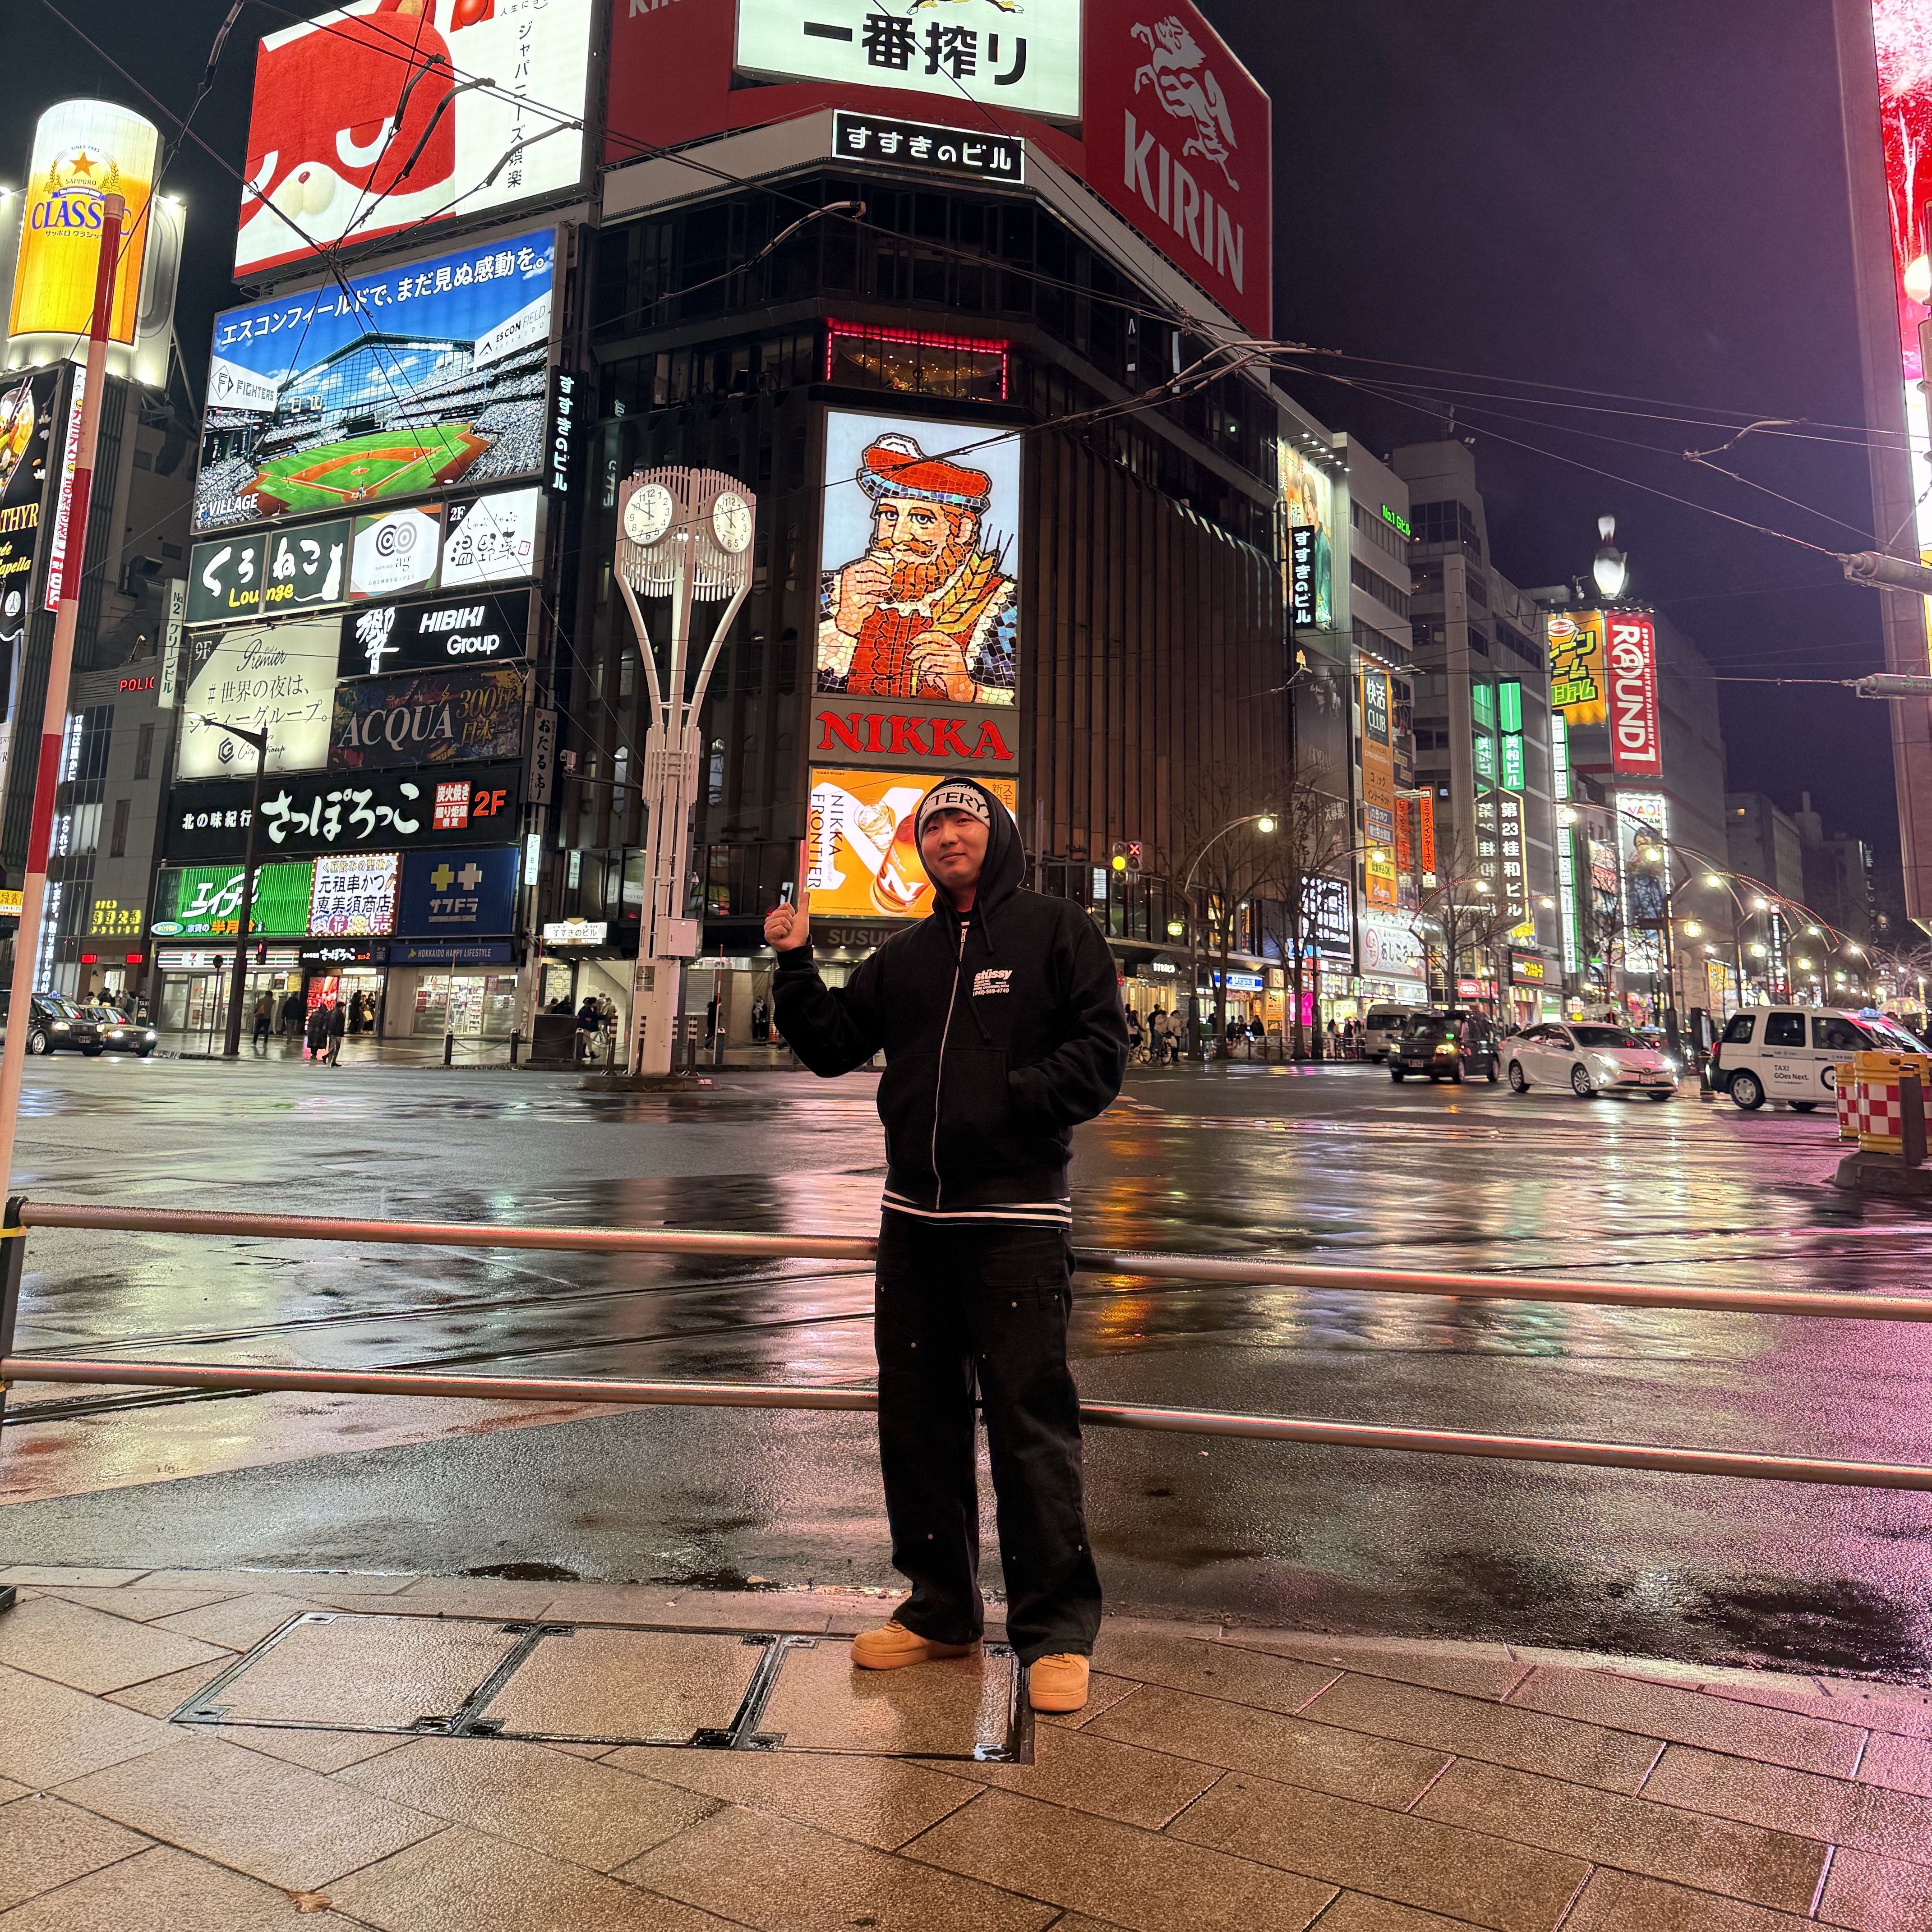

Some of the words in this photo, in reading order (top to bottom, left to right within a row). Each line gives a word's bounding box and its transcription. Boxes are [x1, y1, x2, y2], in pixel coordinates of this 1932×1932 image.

[803, 14, 1027, 85] 一番搾り
[847, 126, 1011, 170] すすきのビル
[1124, 108, 1243, 294] KIRIN
[32, 200, 131, 236] CLASSC
[221, 246, 545, 346] エスコンフィールドで、まだ見ぬ感動を。
[497, 321, 521, 343] ESCON
[523, 305, 546, 328] FIELD
[236, 380, 274, 401] FIGHTERS
[552, 376, 574, 492] すすきのビル
[639, 493, 646, 502] 11
[646, 489, 655, 498] 12
[658, 491, 662, 499] 1
[663, 497, 668, 506] 2
[723, 497, 728, 506] 11
[729, 497, 736, 506] 12
[198, 503, 207, 519] F
[209, 493, 259, 516] VILLAGE
[450, 506, 466, 521] 2F
[665, 508, 670, 516] 3
[0, 503, 39, 533] THYR
[632, 524, 637, 532] 8
[716, 524, 721, 533] 8
[743, 524, 747, 532] 3
[639, 530, 644, 538] 7
[646, 532, 651, 540] 6
[655, 528, 659, 536] 5
[722, 534, 726, 542] 7
[734, 538, 738, 547] 5
[728, 539, 732, 547] 6
[203, 536, 321, 597] くろねこ
[1294, 531, 1312, 623] すすきのビル
[229, 582, 294, 608] Lounge
[173, 603, 180, 614] 2
[419, 606, 485, 634] HIBIKI
[195, 640, 212, 661] 9F
[236, 639, 287, 672] Premier
[447, 634, 500, 656] Group
[1367, 678, 1386, 711] 快活
[337, 703, 453, 751] ACQUA
[1368, 708, 1386, 733] CLUB
[816, 711, 1014, 760] NIKKA
[1505, 735, 1521, 787] 美松ビル
[437, 784, 470, 802] 炭火焼き
[473, 790, 506, 816] 2F
[182, 810, 252, 831] 北の味紀行
[261, 783, 420, 843] さっぽろっこ
[829, 795, 844, 856] NIKKA
[1424, 800, 1433, 872] コミック・インターネット
[808, 793, 825, 888] FRONTIER
[330, 859, 385, 873] 昼飲みの聖地
[1501, 802, 1523, 917] 第23桂和ビル
[318, 874, 385, 893] 元祖串かつ
[315, 894, 392, 914] 恵美須商店
[333, 921, 344, 933] 1F
[553, 929, 597, 937] すすきのビル
[418, 949, 444, 957] HOKKAIDO
[446, 949, 462, 957] HAPPY
[464, 948, 491, 957] LIFESTYLE
